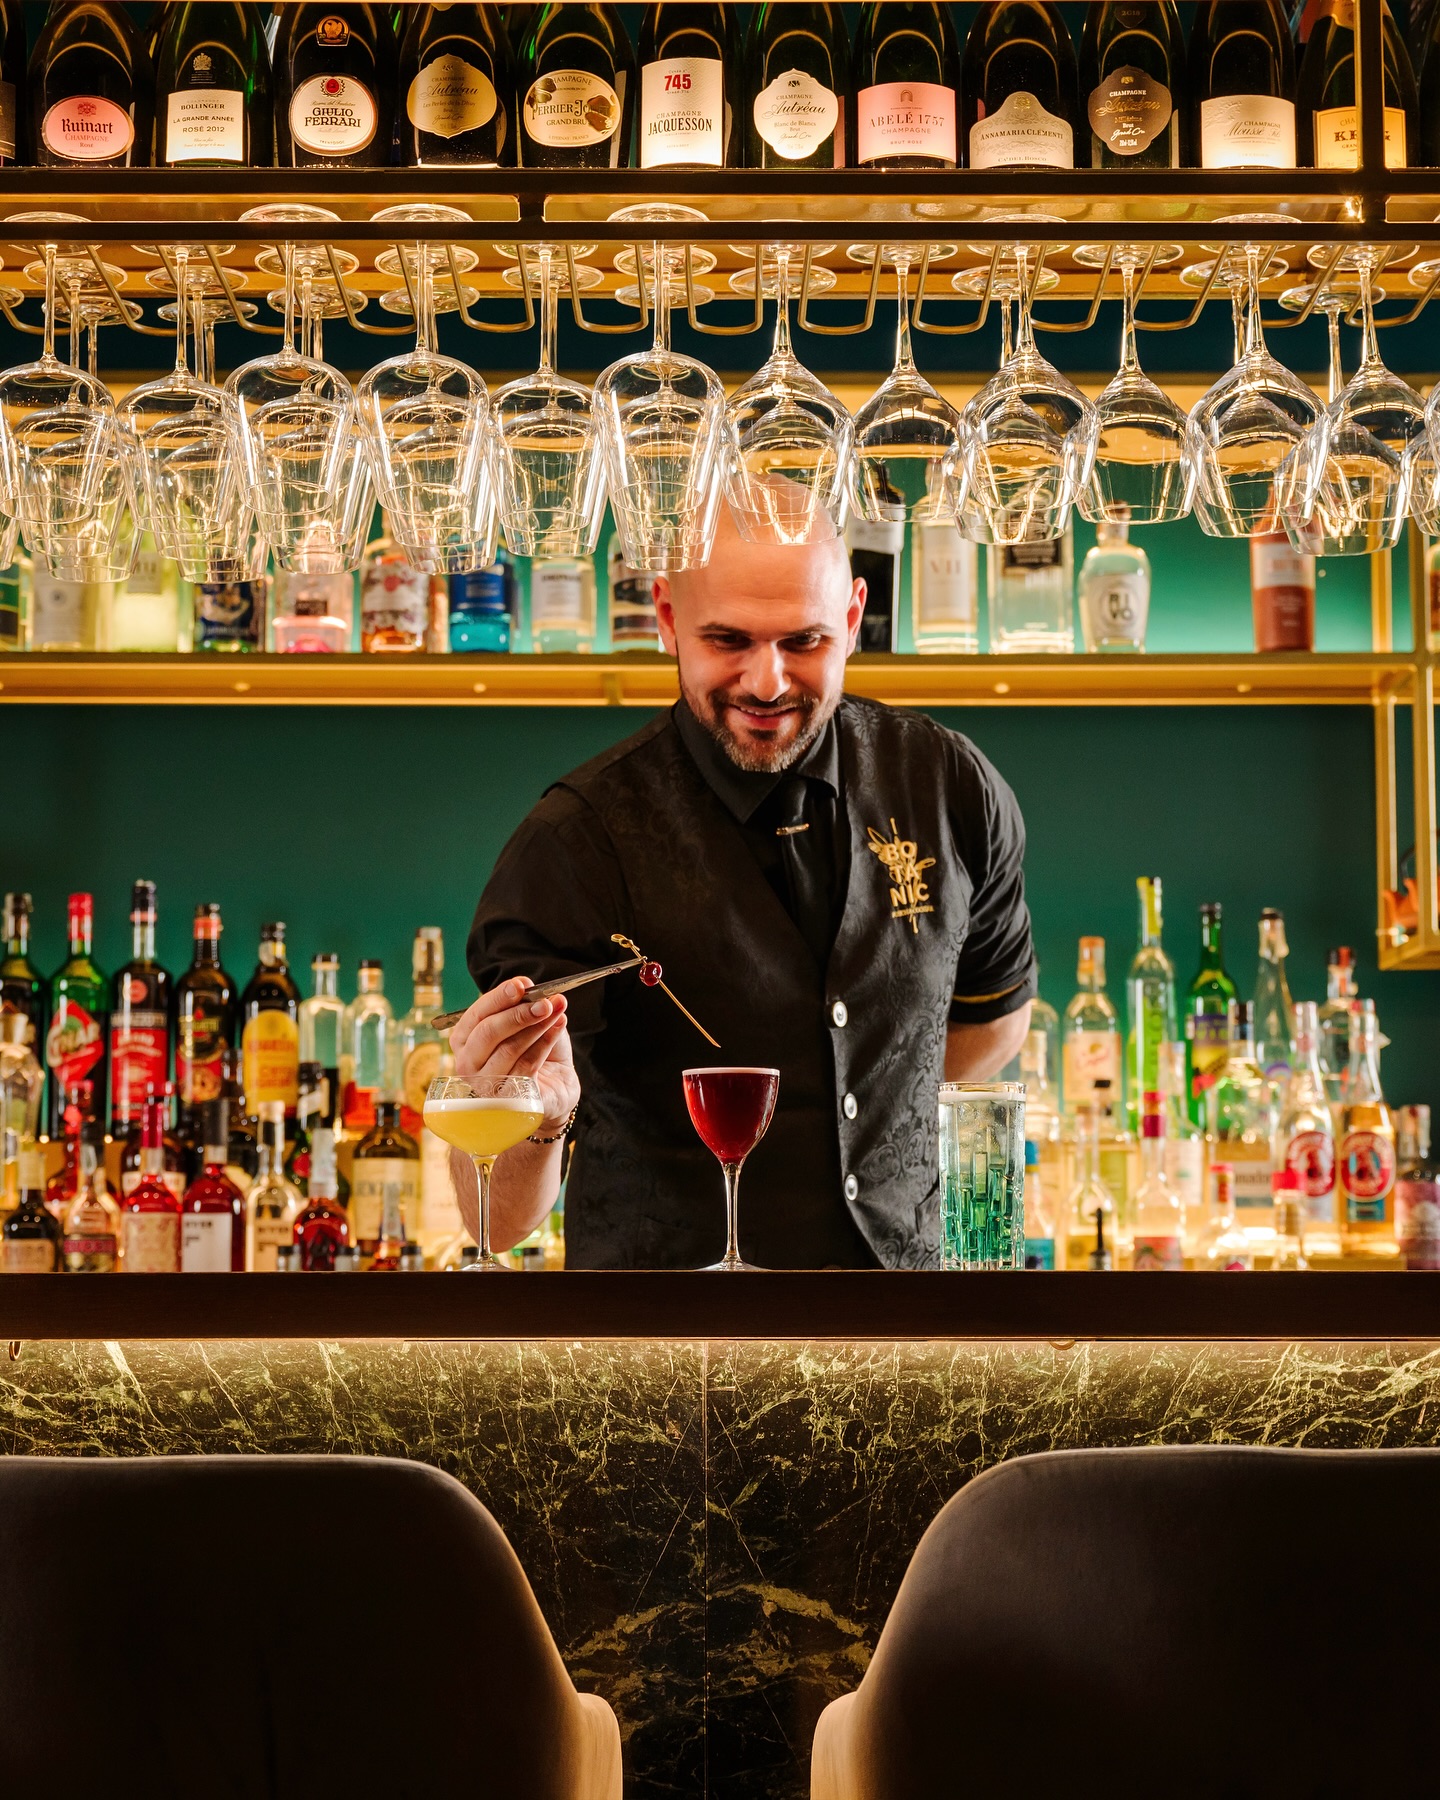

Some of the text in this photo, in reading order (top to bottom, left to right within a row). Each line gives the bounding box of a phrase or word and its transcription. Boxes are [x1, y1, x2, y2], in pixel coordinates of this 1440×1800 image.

[664, 74, 692, 91] 745
[1109, 90, 1147, 98] CHAMPAGNE
[312, 107, 354, 117] GIULIO
[657, 111, 702, 119] CHAMPAGNE
[762, 101, 826, 119] Autréau
[212, 115, 235, 123] ANNÉE
[304, 116, 362, 128] FERRARI
[546, 119, 572, 127] GRAND
[870, 111, 945, 128] ABELÉ 1757
[62, 118, 114, 134] Ruinart
[648, 117, 713, 136] JACQUESSON
[881, 127, 931, 135] CHAMPAGNE
[65, 133, 109, 142] CHAMPAGNE
[980, 128, 1063, 141] ANNAMARIA CLEMENTI
[885, 841, 917, 861] BO
[889, 861, 921, 884] TA
[889, 882, 930, 908] NIC
